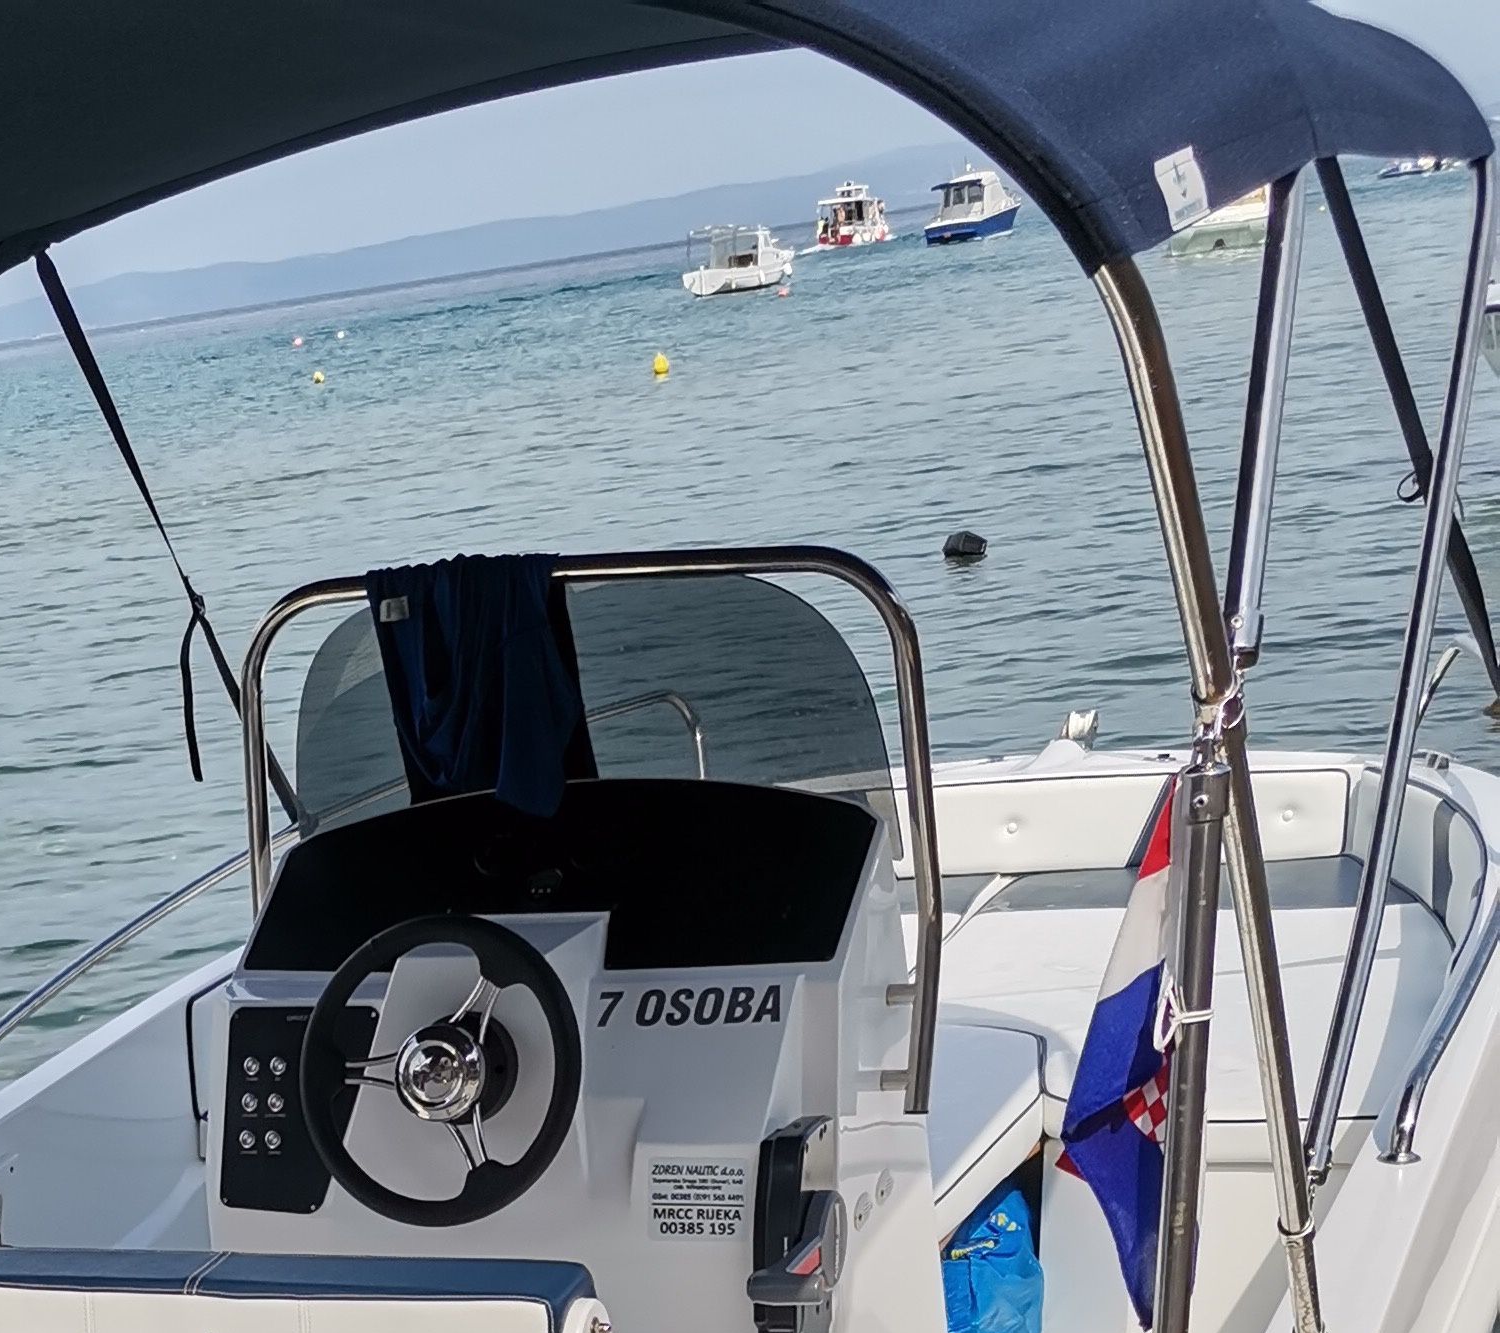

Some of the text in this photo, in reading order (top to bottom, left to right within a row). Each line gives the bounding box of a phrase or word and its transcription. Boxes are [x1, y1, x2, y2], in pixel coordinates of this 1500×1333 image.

[597, 985, 781, 1027] 7 OSOBA
[652, 1165, 745, 1177] ZOREN NAUTIC d.o.o.
[653, 1208, 742, 1221] MRCC RIJEKA
[660, 1221, 736, 1235] 00385 195
